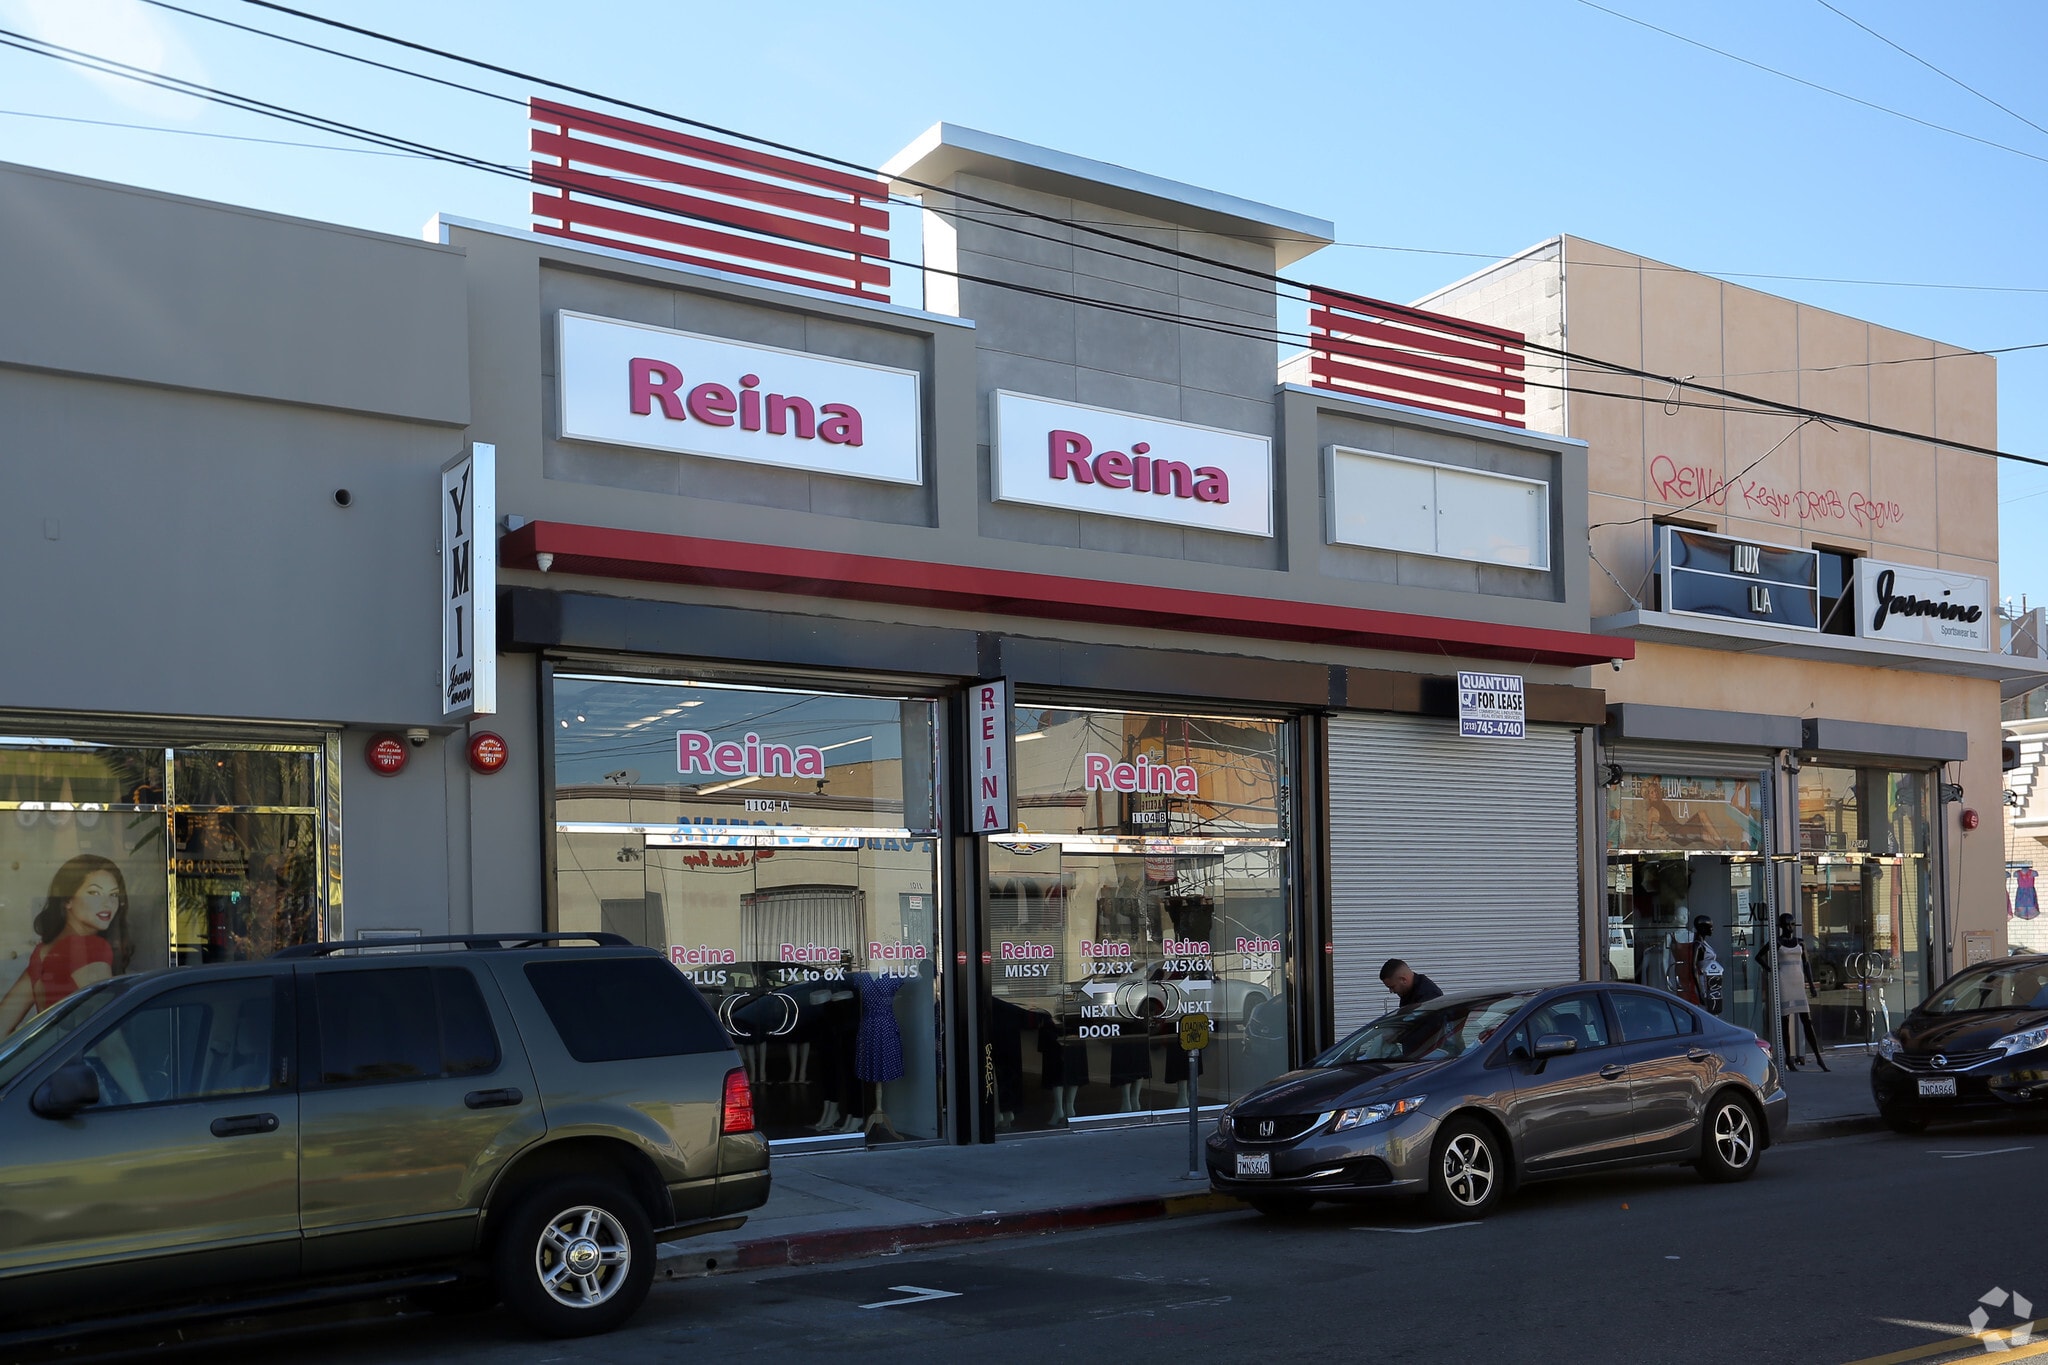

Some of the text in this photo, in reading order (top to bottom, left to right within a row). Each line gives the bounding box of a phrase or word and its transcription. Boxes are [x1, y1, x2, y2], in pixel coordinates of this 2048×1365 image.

[629, 357, 863, 447] Reina
[1049, 430, 1230, 504] Reina
[449, 464, 470, 659] YMI
[1734, 544, 1760, 574] LUX
[1751, 586, 1772, 614] LA
[1874, 569, 1982, 631] Jasmine
[447, 664, 471, 697] Jeans
[1462, 675, 1519, 691] QUANTUM
[451, 686, 472, 704] wear
[1478, 692, 1522, 710] FOR LEASE
[1477, 721, 1521, 735] 745-4740
[676, 729, 826, 779] Reina
[981, 686, 998, 829] REINA
[1084, 752, 1198, 794] Reina
[1667, 779, 1682, 798] LUX
[746, 800, 789, 812] 1104 A
[1678, 802, 1689, 818] LA
[1133, 813, 1155, 823] 1104
[670, 944, 736, 964] Reina
[779, 942, 841, 962] Reina
[868, 941, 927, 960] Reina
[1001, 940, 1054, 960] Reina
[1080, 939, 1131, 957] Reina
[1162, 938, 1210, 956] Reina
[1236, 937, 1281, 953] Reina
[778, 967, 845, 982] 1X to 6X
[878, 965, 919, 979] PLUS
[1005, 963, 1050, 977] MISSY
[1080, 962, 1133, 974] 1X2X3X
[1162, 960, 1212, 972] 4X5X6X
[1081, 1005, 1117, 1018] NEXT
[1179, 1000, 1212, 1013] NEXT
[1079, 1023, 1120, 1038] DOOR
